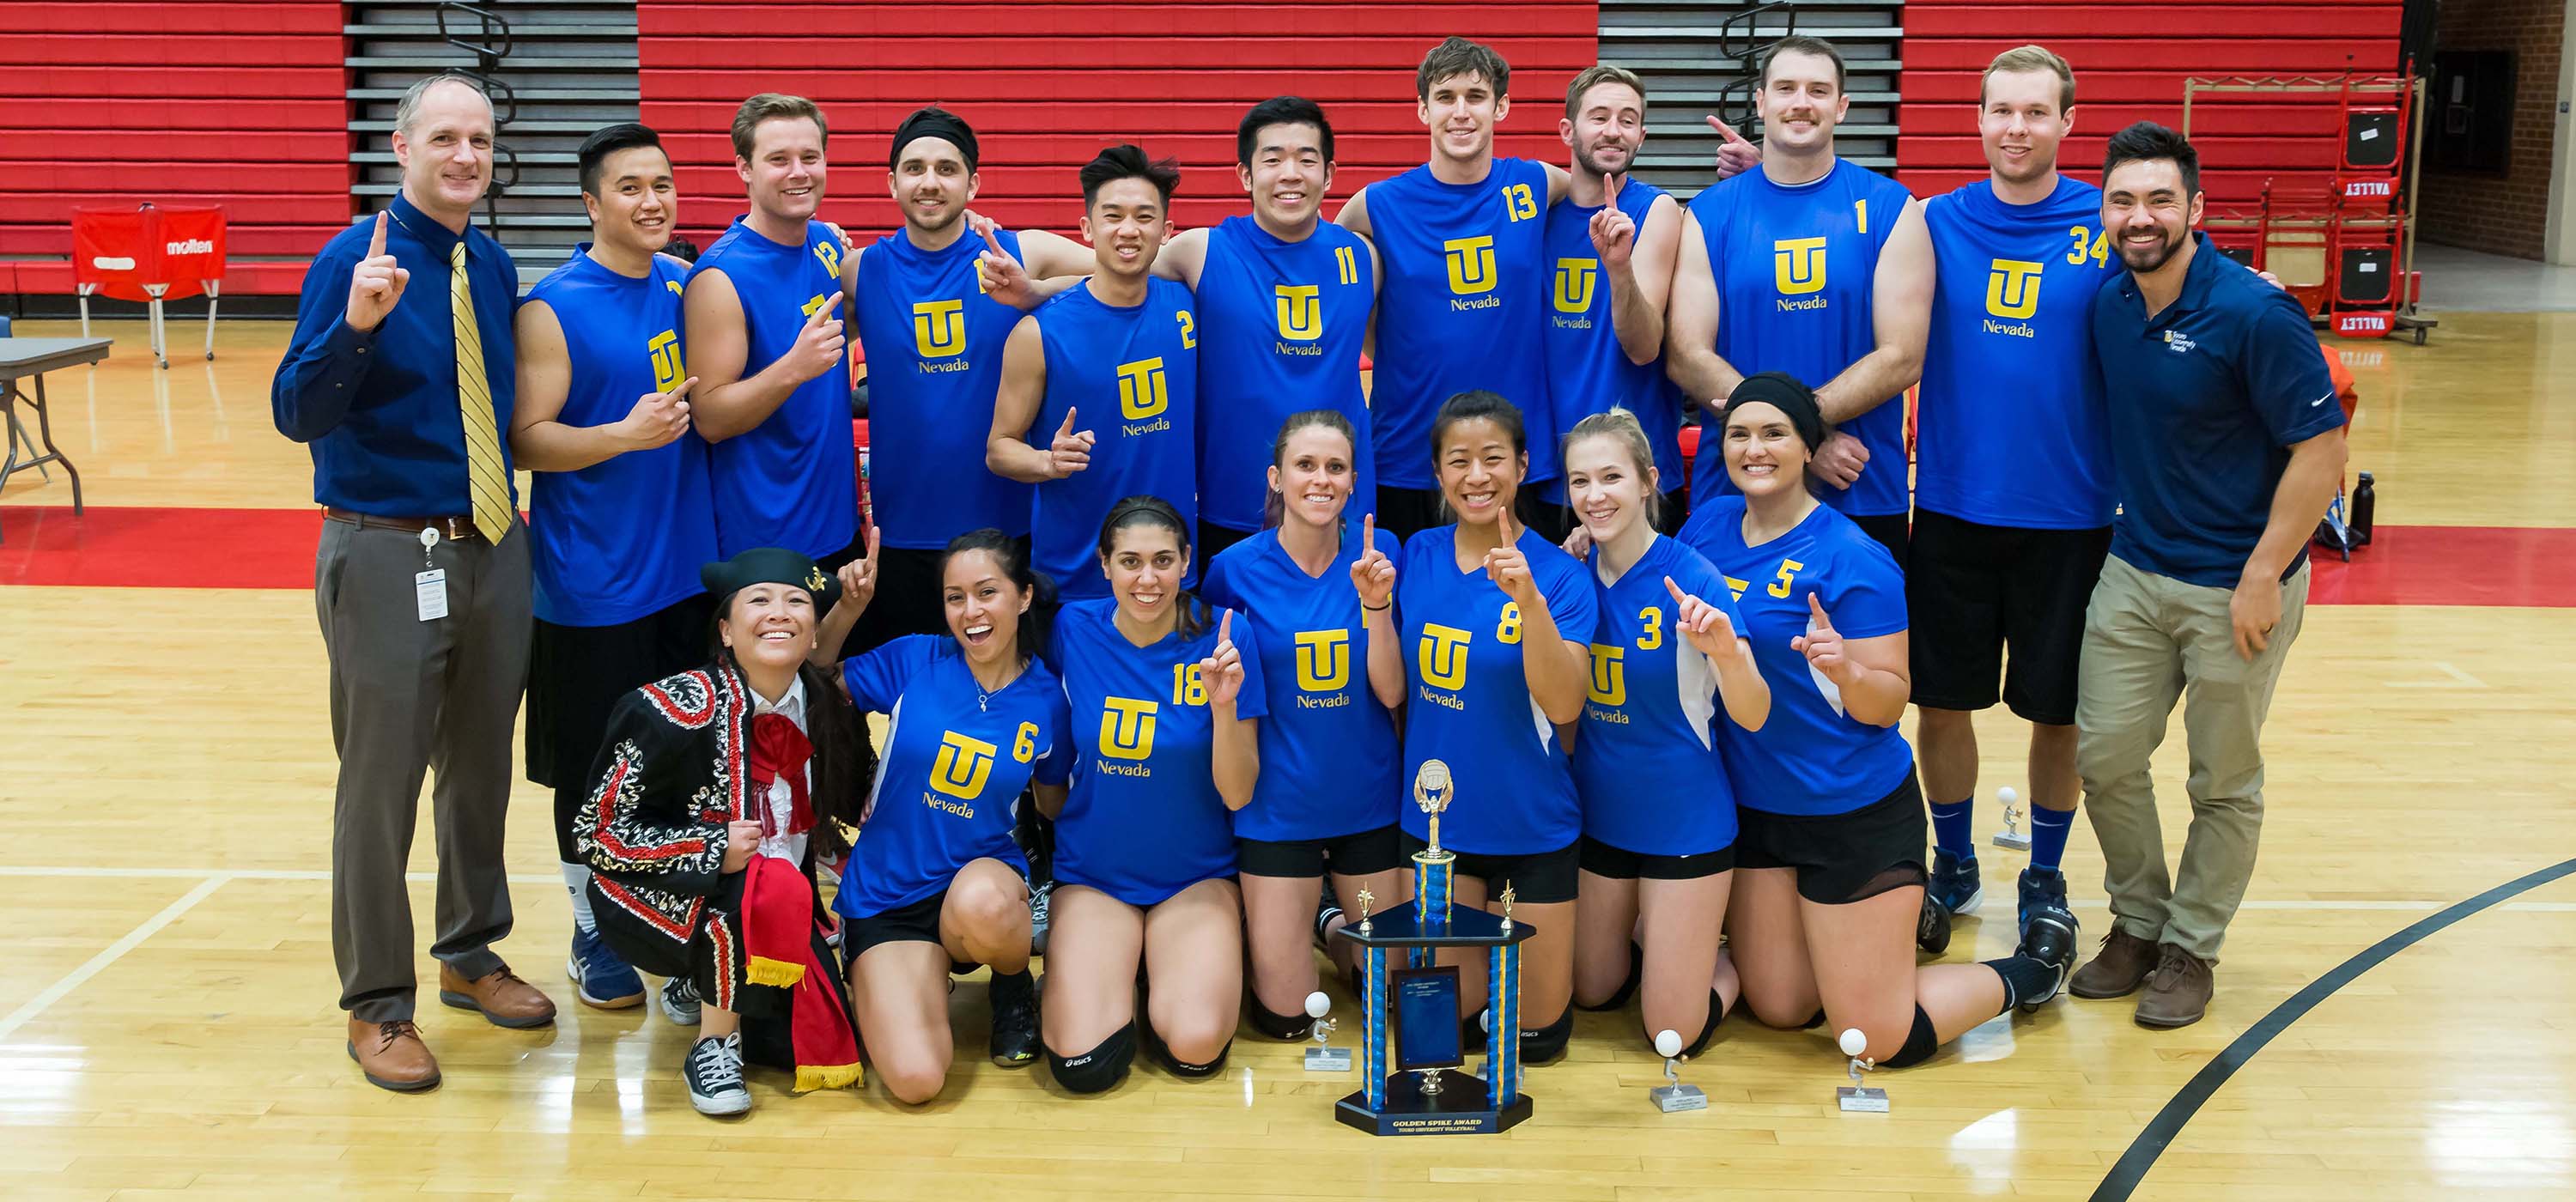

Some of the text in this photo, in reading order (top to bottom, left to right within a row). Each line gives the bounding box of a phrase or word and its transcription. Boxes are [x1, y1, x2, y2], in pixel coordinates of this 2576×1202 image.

[2345, 182, 2391, 197] VALLEY
[1502, 183, 1538, 222] 13
[1856, 199, 1868, 234] 1
[167, 239, 212, 255] molten
[2067, 226, 2110, 268] 34
[1335, 246, 1358, 284] 11
[1451, 294, 1500, 312] Nevada
[1777, 294, 1827, 313] Nevada
[1176, 310, 1196, 349] 2
[1552, 316, 1592, 328] Nevada
[1983, 319, 2034, 338] Nevada
[2341, 317, 2386, 331] VALLEY
[1275, 341, 1322, 356] Nevada
[918, 358, 969, 373] Nevada
[1121, 417, 1170, 438] Nevada
[1766, 559, 1802, 598] 5
[1496, 601, 1522, 645] 8
[1637, 607, 1662, 650] 3
[1173, 663, 1209, 706] 18
[1297, 692, 1350, 708] Nevada
[1420, 686, 1465, 711] Nevada
[1585, 704, 1629, 724] Nevada
[1012, 721, 1039, 763] 6
[1097, 760, 1151, 777] Nevada
[922, 792, 975, 819] Nevada
[1072, 1055, 1092, 1066] asics
